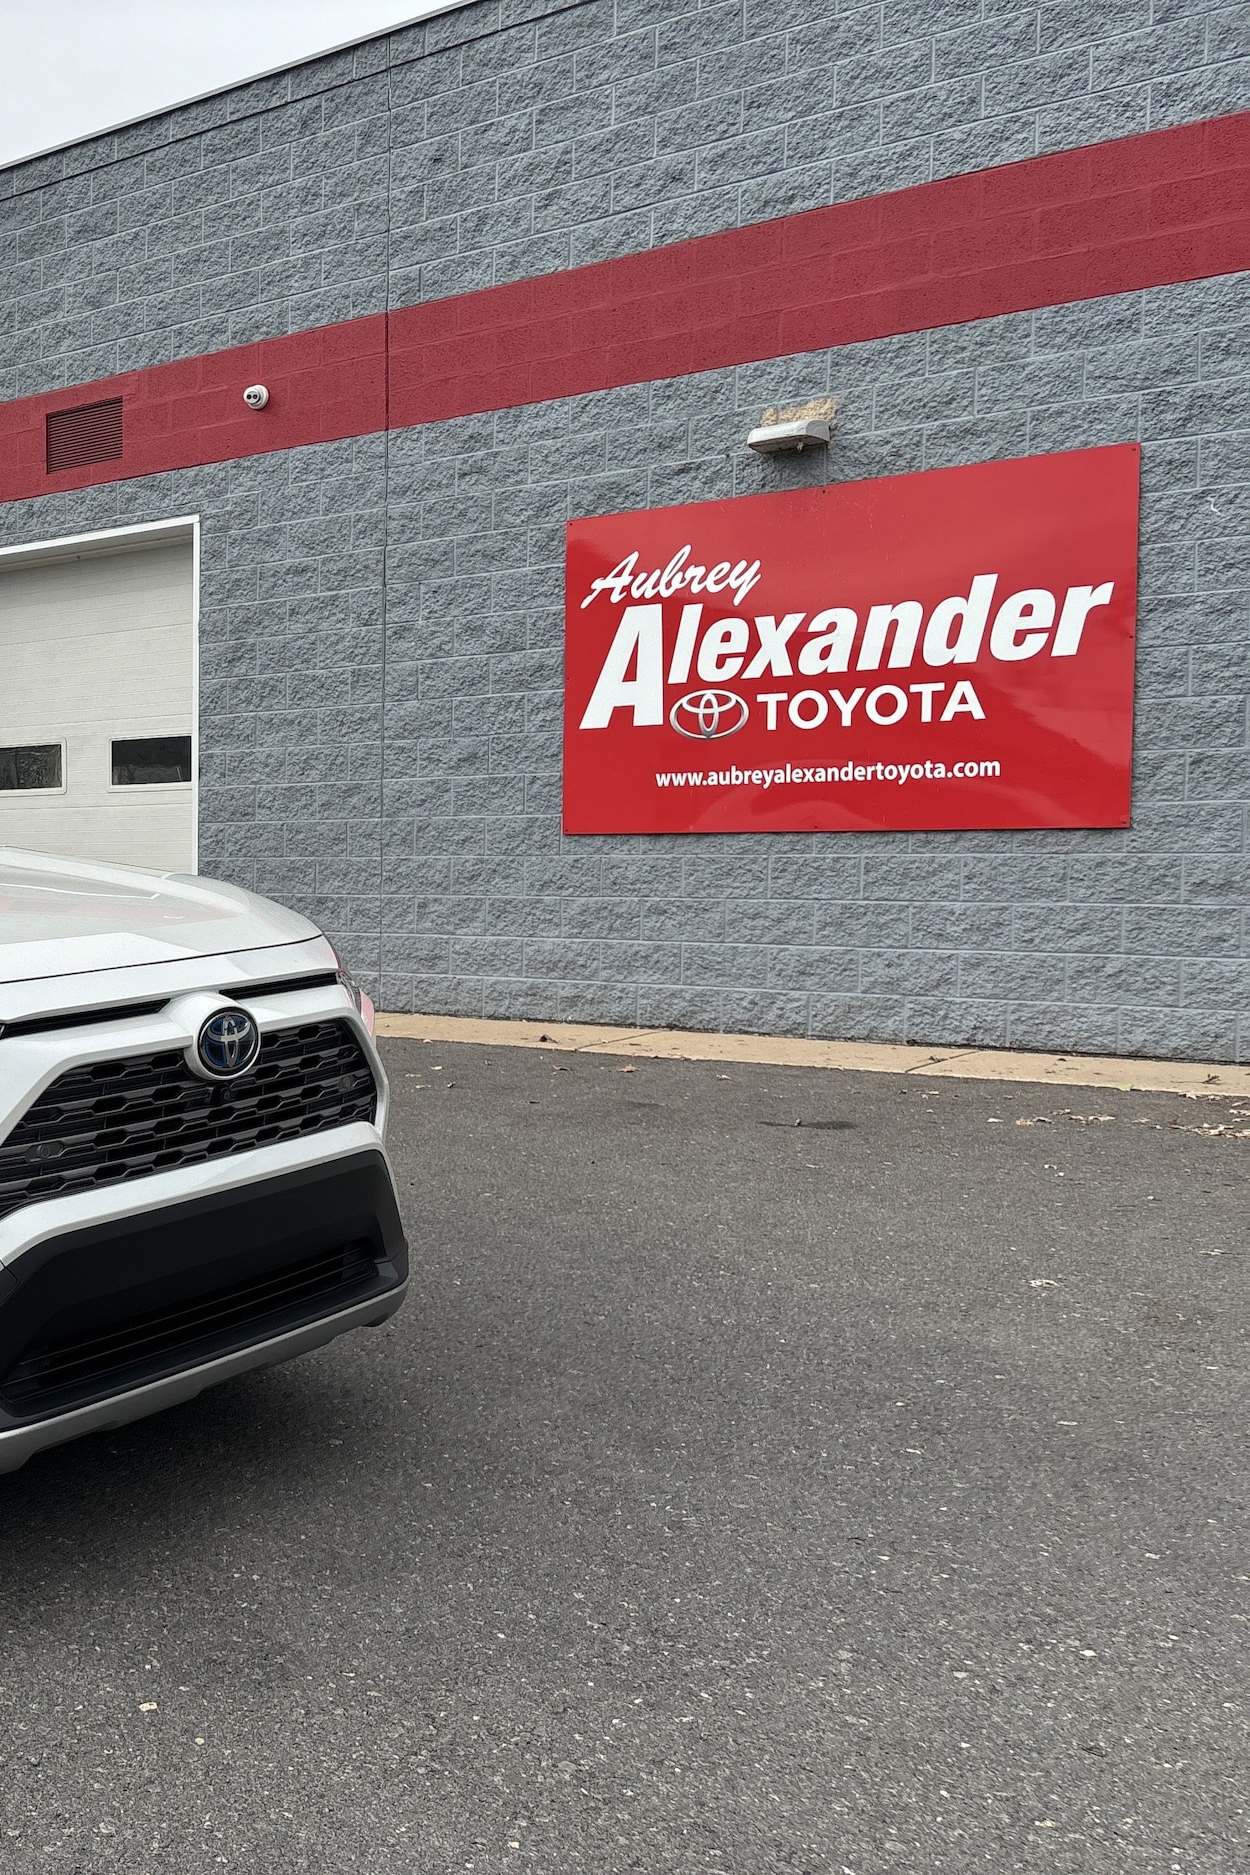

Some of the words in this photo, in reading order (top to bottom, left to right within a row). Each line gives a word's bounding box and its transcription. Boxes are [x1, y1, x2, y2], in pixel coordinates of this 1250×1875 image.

[580, 544, 762, 610] Aubrey
[578, 573, 1115, 730] Alexander
[756, 680, 986, 731] TOYOTA
[655, 759, 1001, 790] www.aubreyalexandertoyota.com
